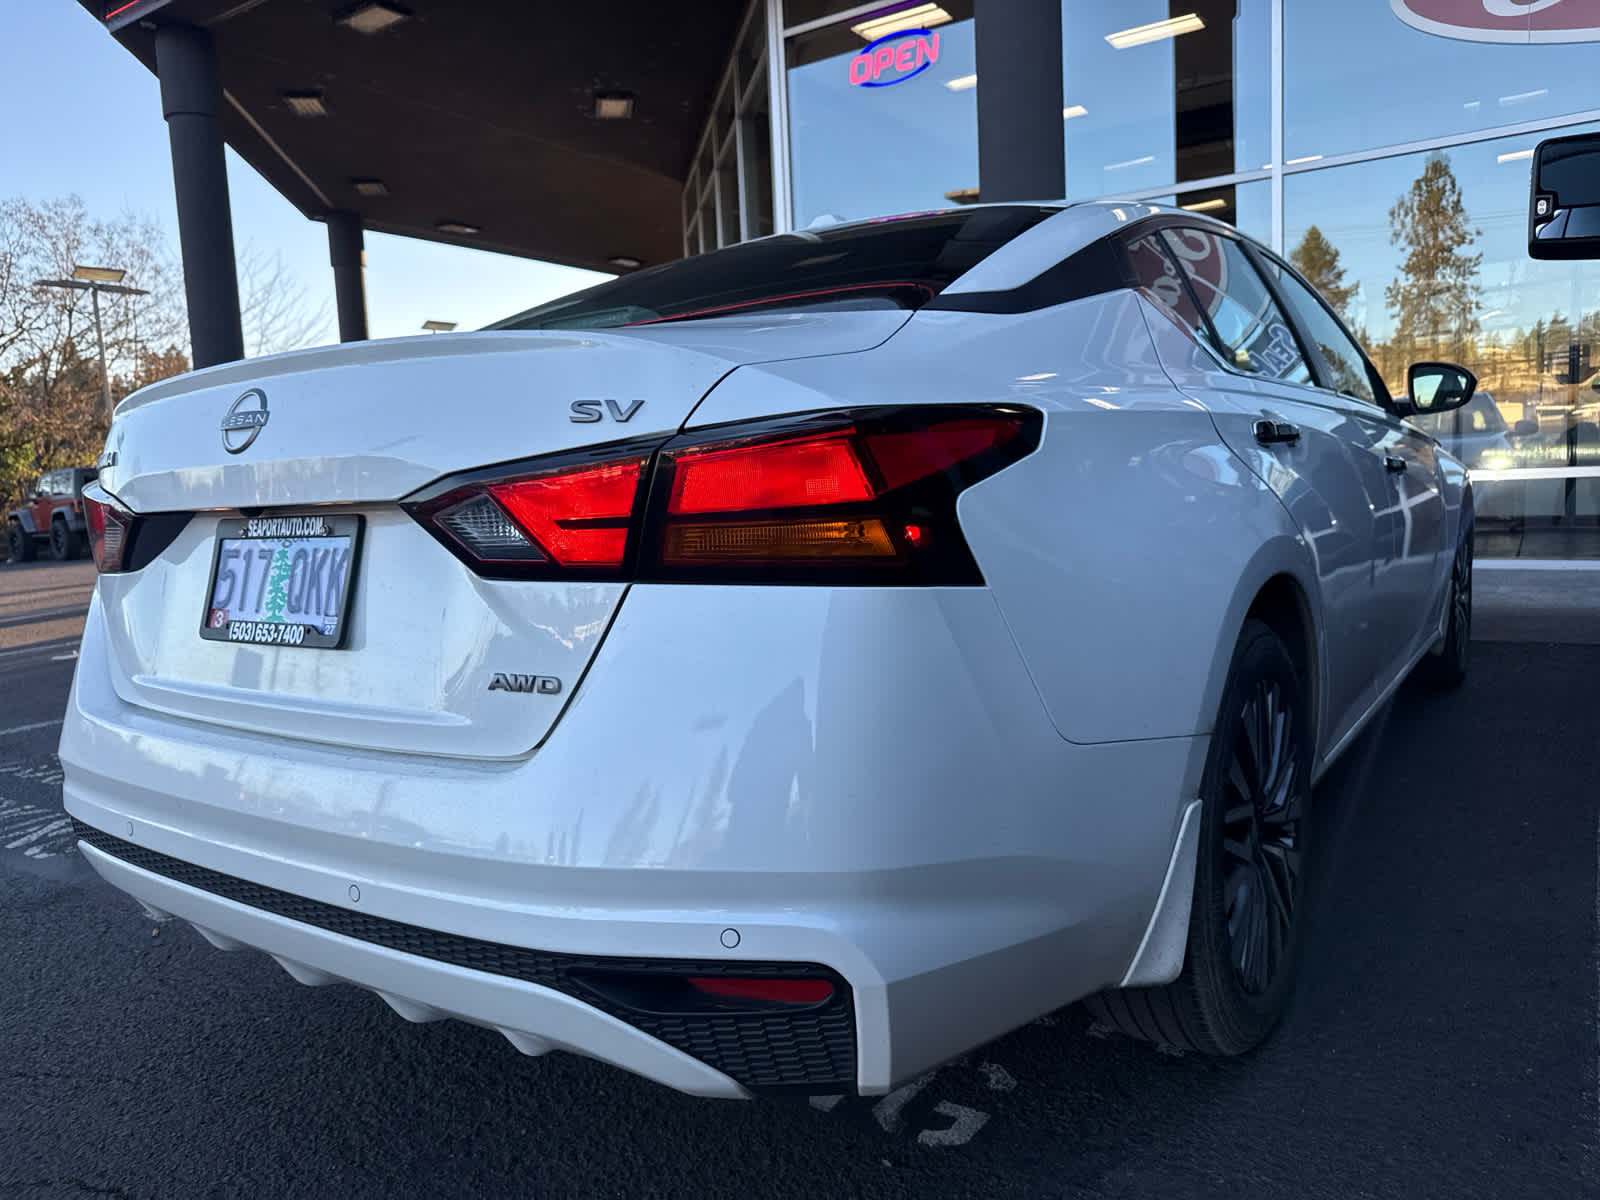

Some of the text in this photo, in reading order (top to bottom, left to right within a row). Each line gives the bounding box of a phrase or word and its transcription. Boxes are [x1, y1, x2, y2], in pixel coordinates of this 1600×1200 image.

[849, 33, 940, 85] OPEN
[221, 412, 267, 427] SSAN
[569, 399, 645, 423] SV
[248, 517, 324, 537] SEAPORTAUTO.COM
[214, 549, 273, 614] 517
[214, 611, 225, 628] 3
[324, 625, 336, 635] 27
[488, 673, 562, 694] AWD
